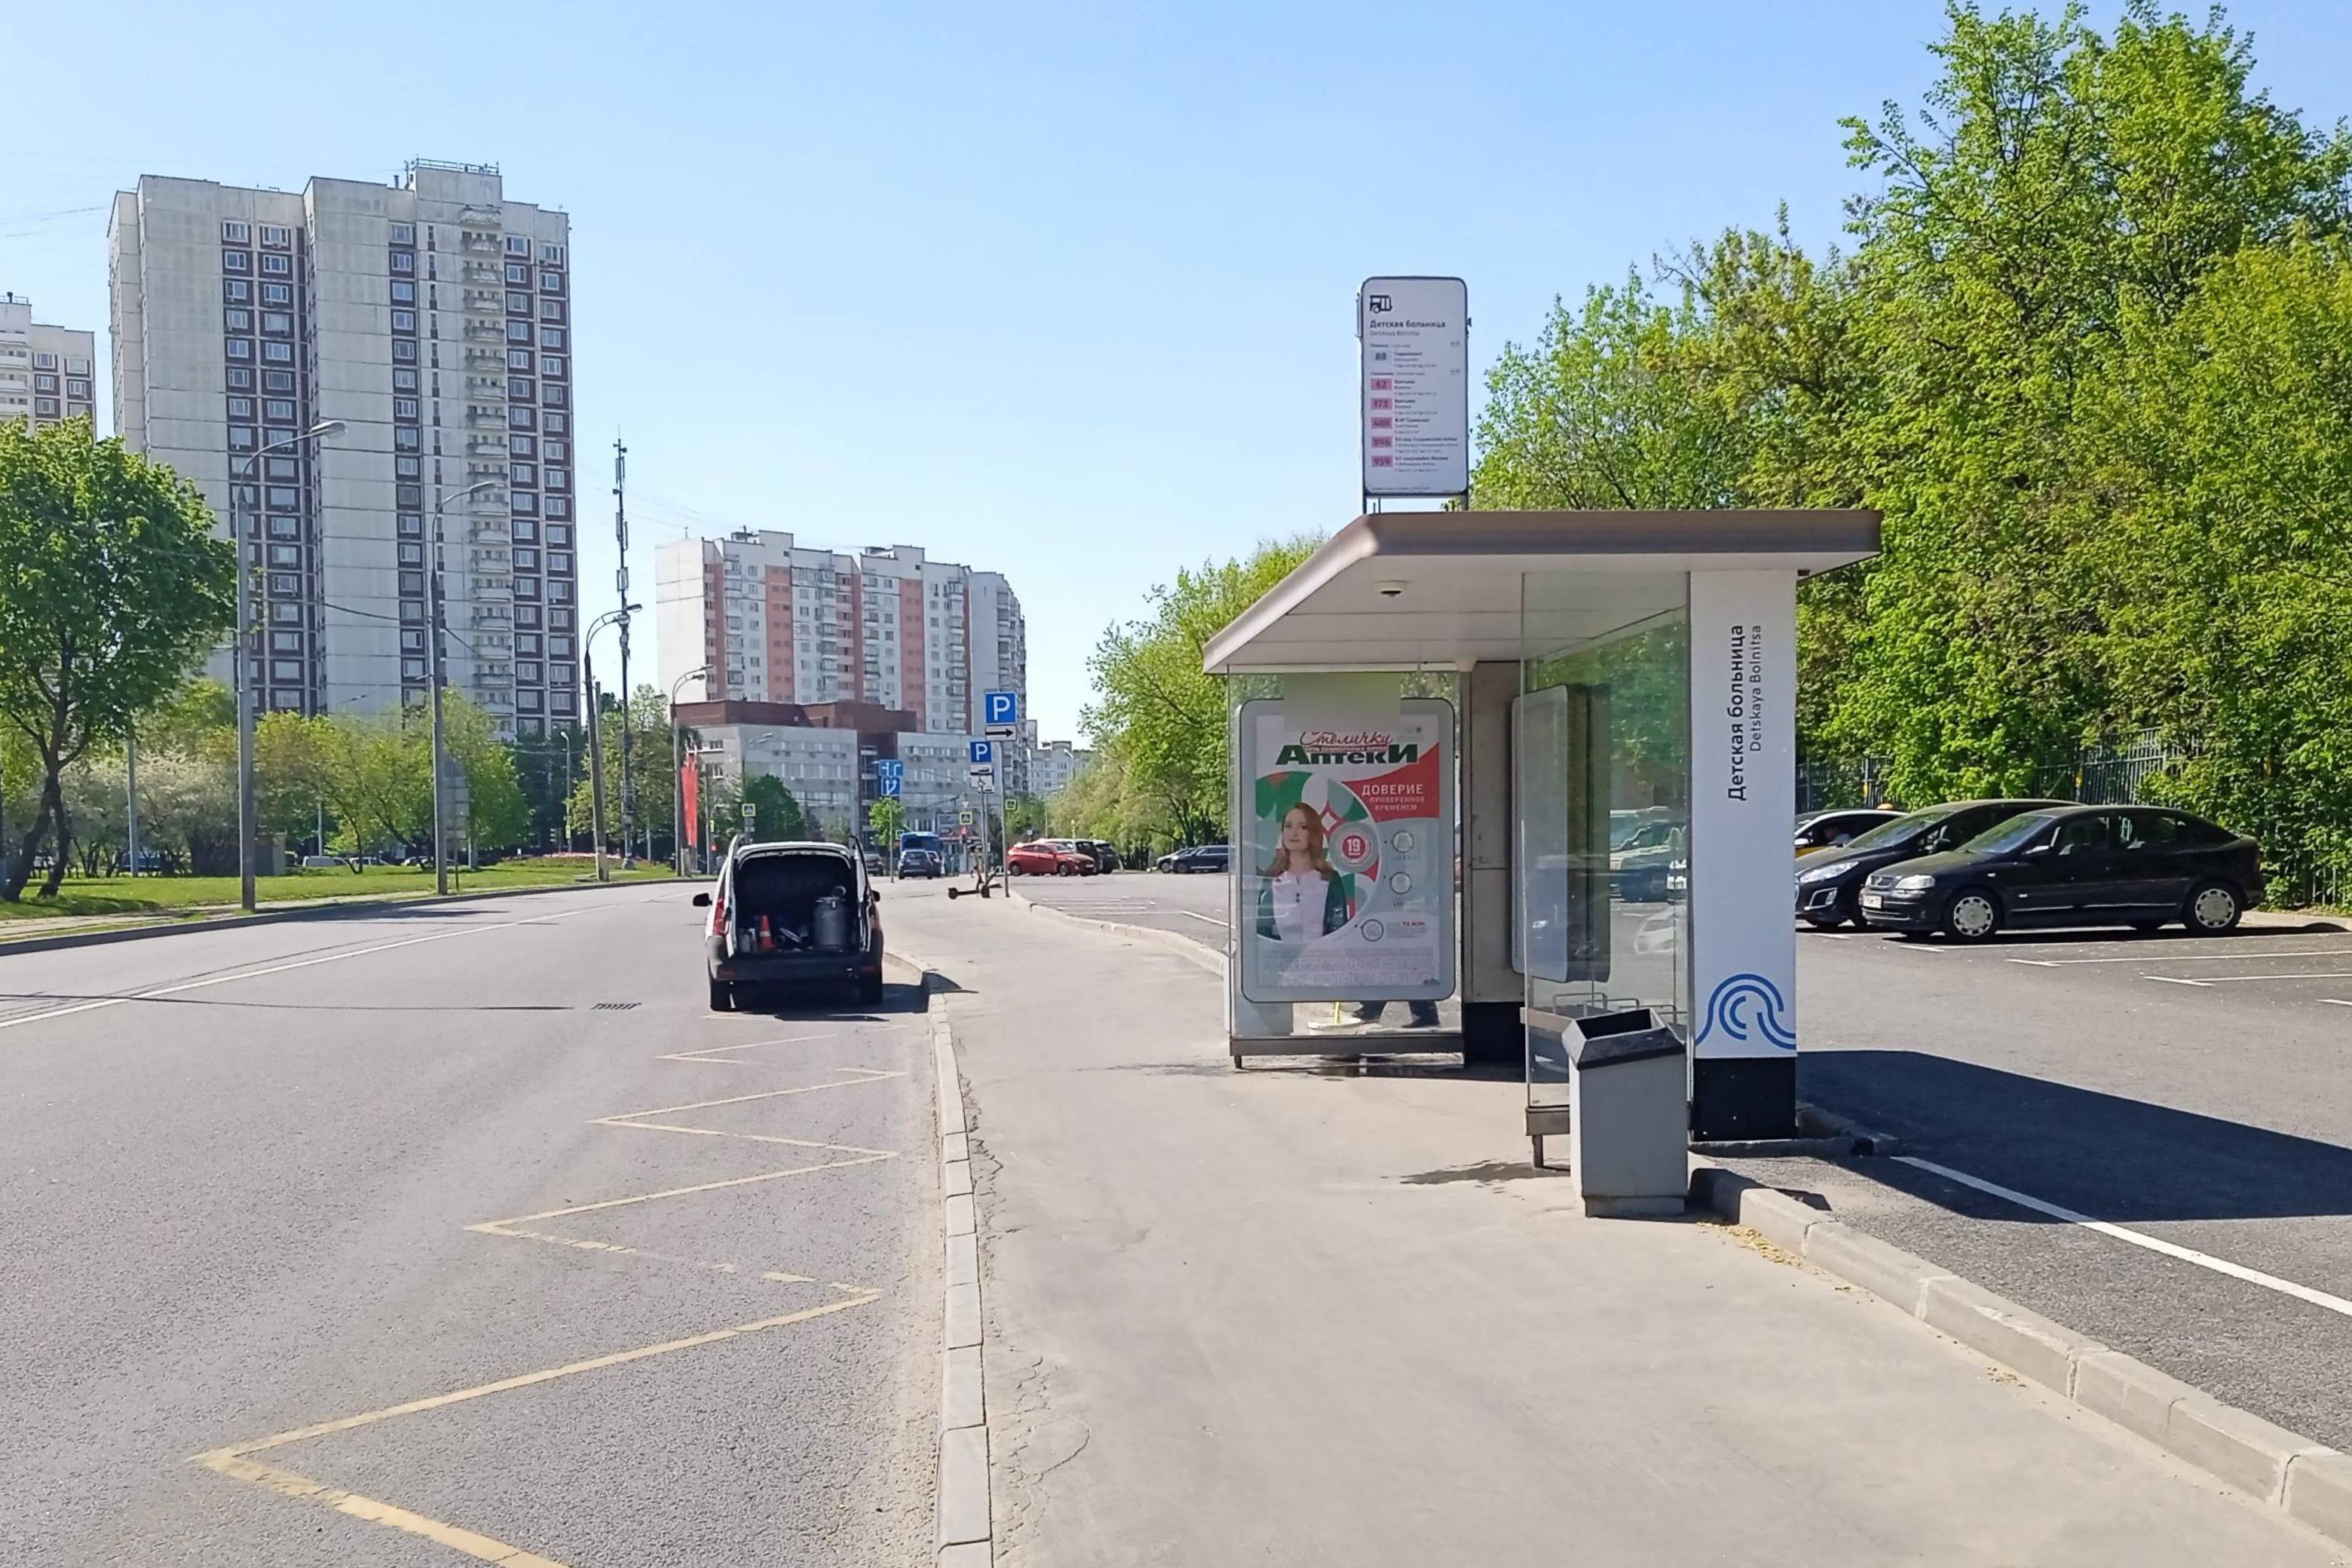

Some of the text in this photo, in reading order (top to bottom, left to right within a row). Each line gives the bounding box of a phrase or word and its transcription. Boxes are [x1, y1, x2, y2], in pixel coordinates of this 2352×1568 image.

[1405, 320, 1446, 329] больница
[1375, 352, 1387, 361] 88
[1749, 625, 1764, 752] Detskaya Bolnitsa
[993, 695, 1011, 721] P
[1727, 625, 1747, 801] Детская больница
[1300, 731, 1392, 746] Столички
[975, 743, 988, 761] P
[1361, 784, 1424, 796] ДОВЕРИЕ
[1346, 838, 1361, 852] 19
